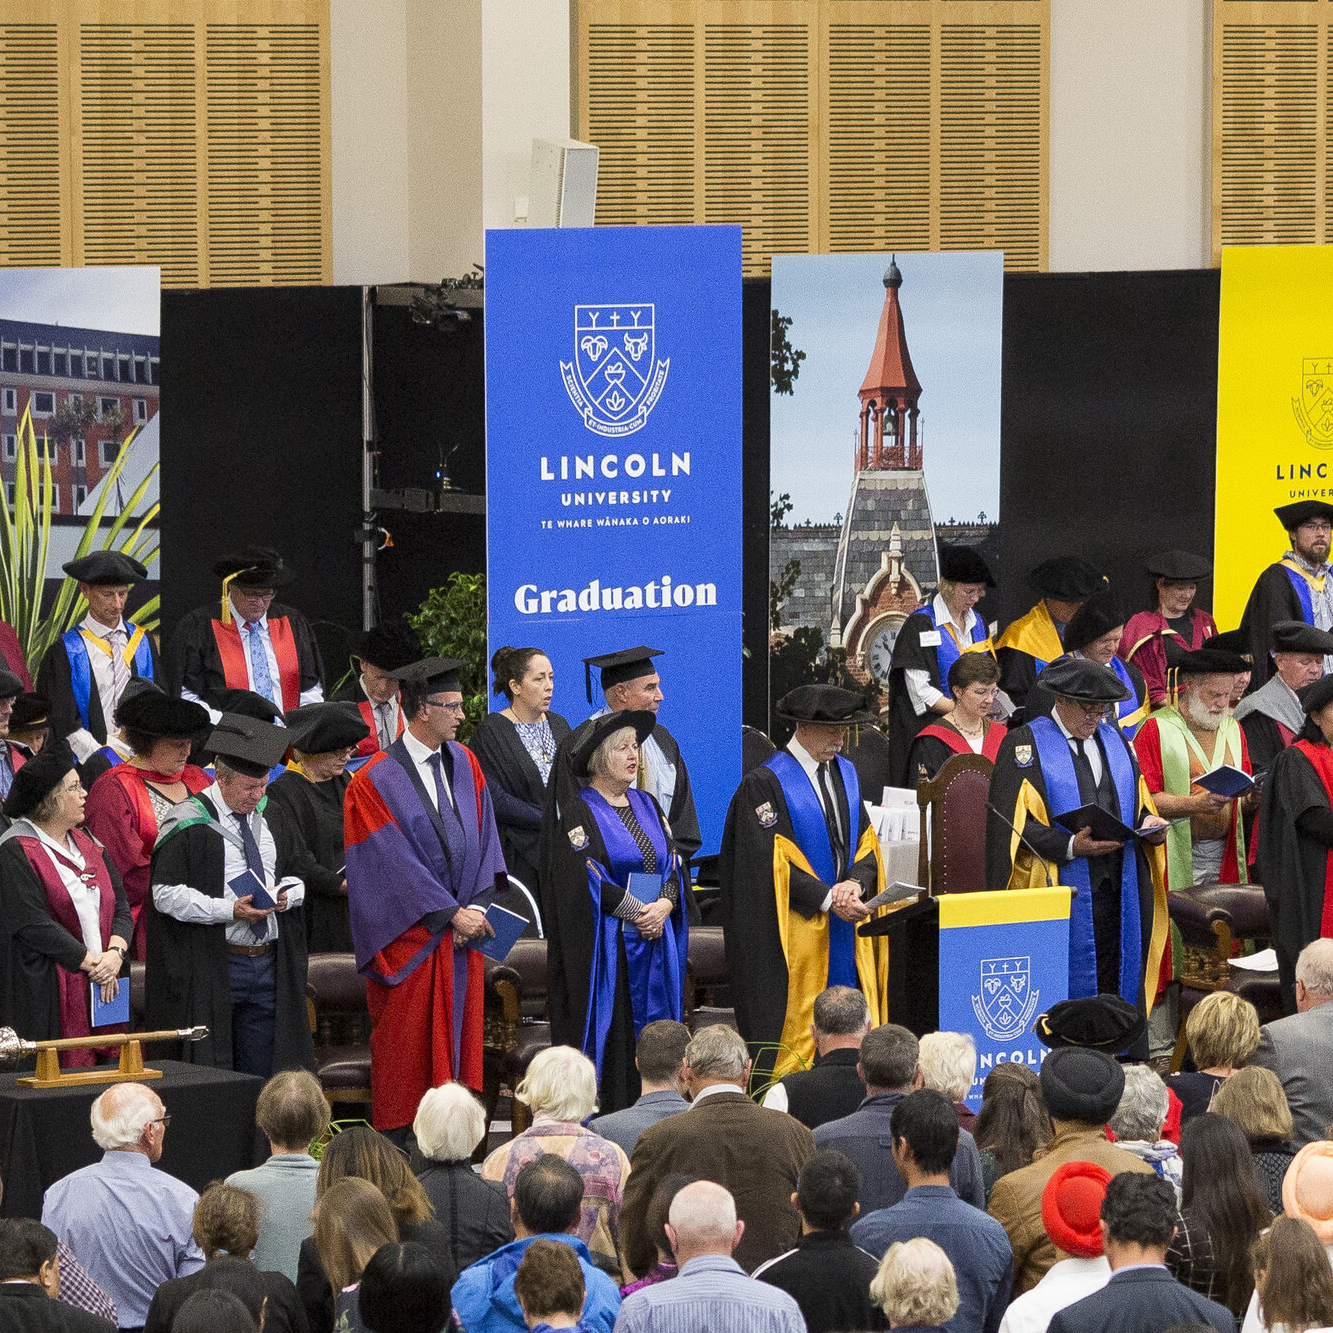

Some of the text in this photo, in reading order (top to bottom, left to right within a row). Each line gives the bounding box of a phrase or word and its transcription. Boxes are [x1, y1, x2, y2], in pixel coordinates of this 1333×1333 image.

[566, 374, 584, 407] SCIENTIA
[540, 451, 691, 481] LINCOLN
[561, 489, 672, 507] UNIVERSITY
[541, 520, 553, 529] TE
[556, 518, 593, 528] WHARE
[642, 516, 650, 526] O
[653, 515, 691, 525] AORAKI
[514, 575, 717, 615] Graduation
[980, 1048, 1053, 1069] NCOLN
